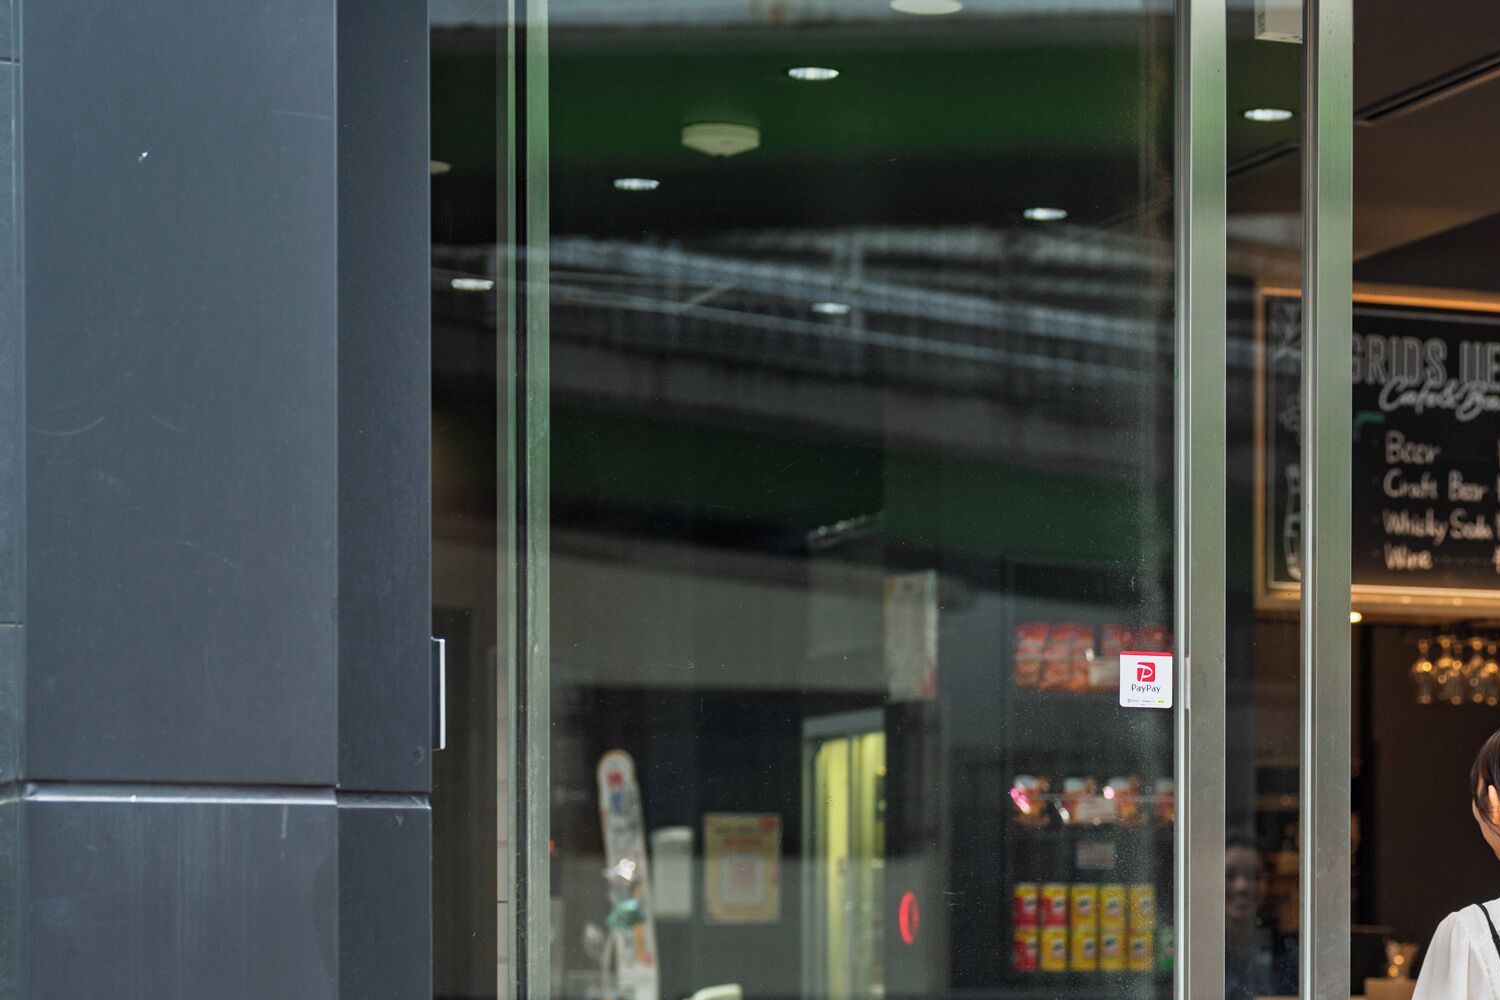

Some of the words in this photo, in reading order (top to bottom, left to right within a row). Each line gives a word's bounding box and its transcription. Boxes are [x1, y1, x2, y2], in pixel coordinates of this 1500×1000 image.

[1352, 333, 1448, 390] GRIDS
[1385, 429, 1442, 464] Beer
[1383, 467, 1438, 499] Craft
[1448, 469, 1489, 502] Beer
[1384, 541, 1433, 570] Wine
[1131, 684, 1161, 693] PayPay
